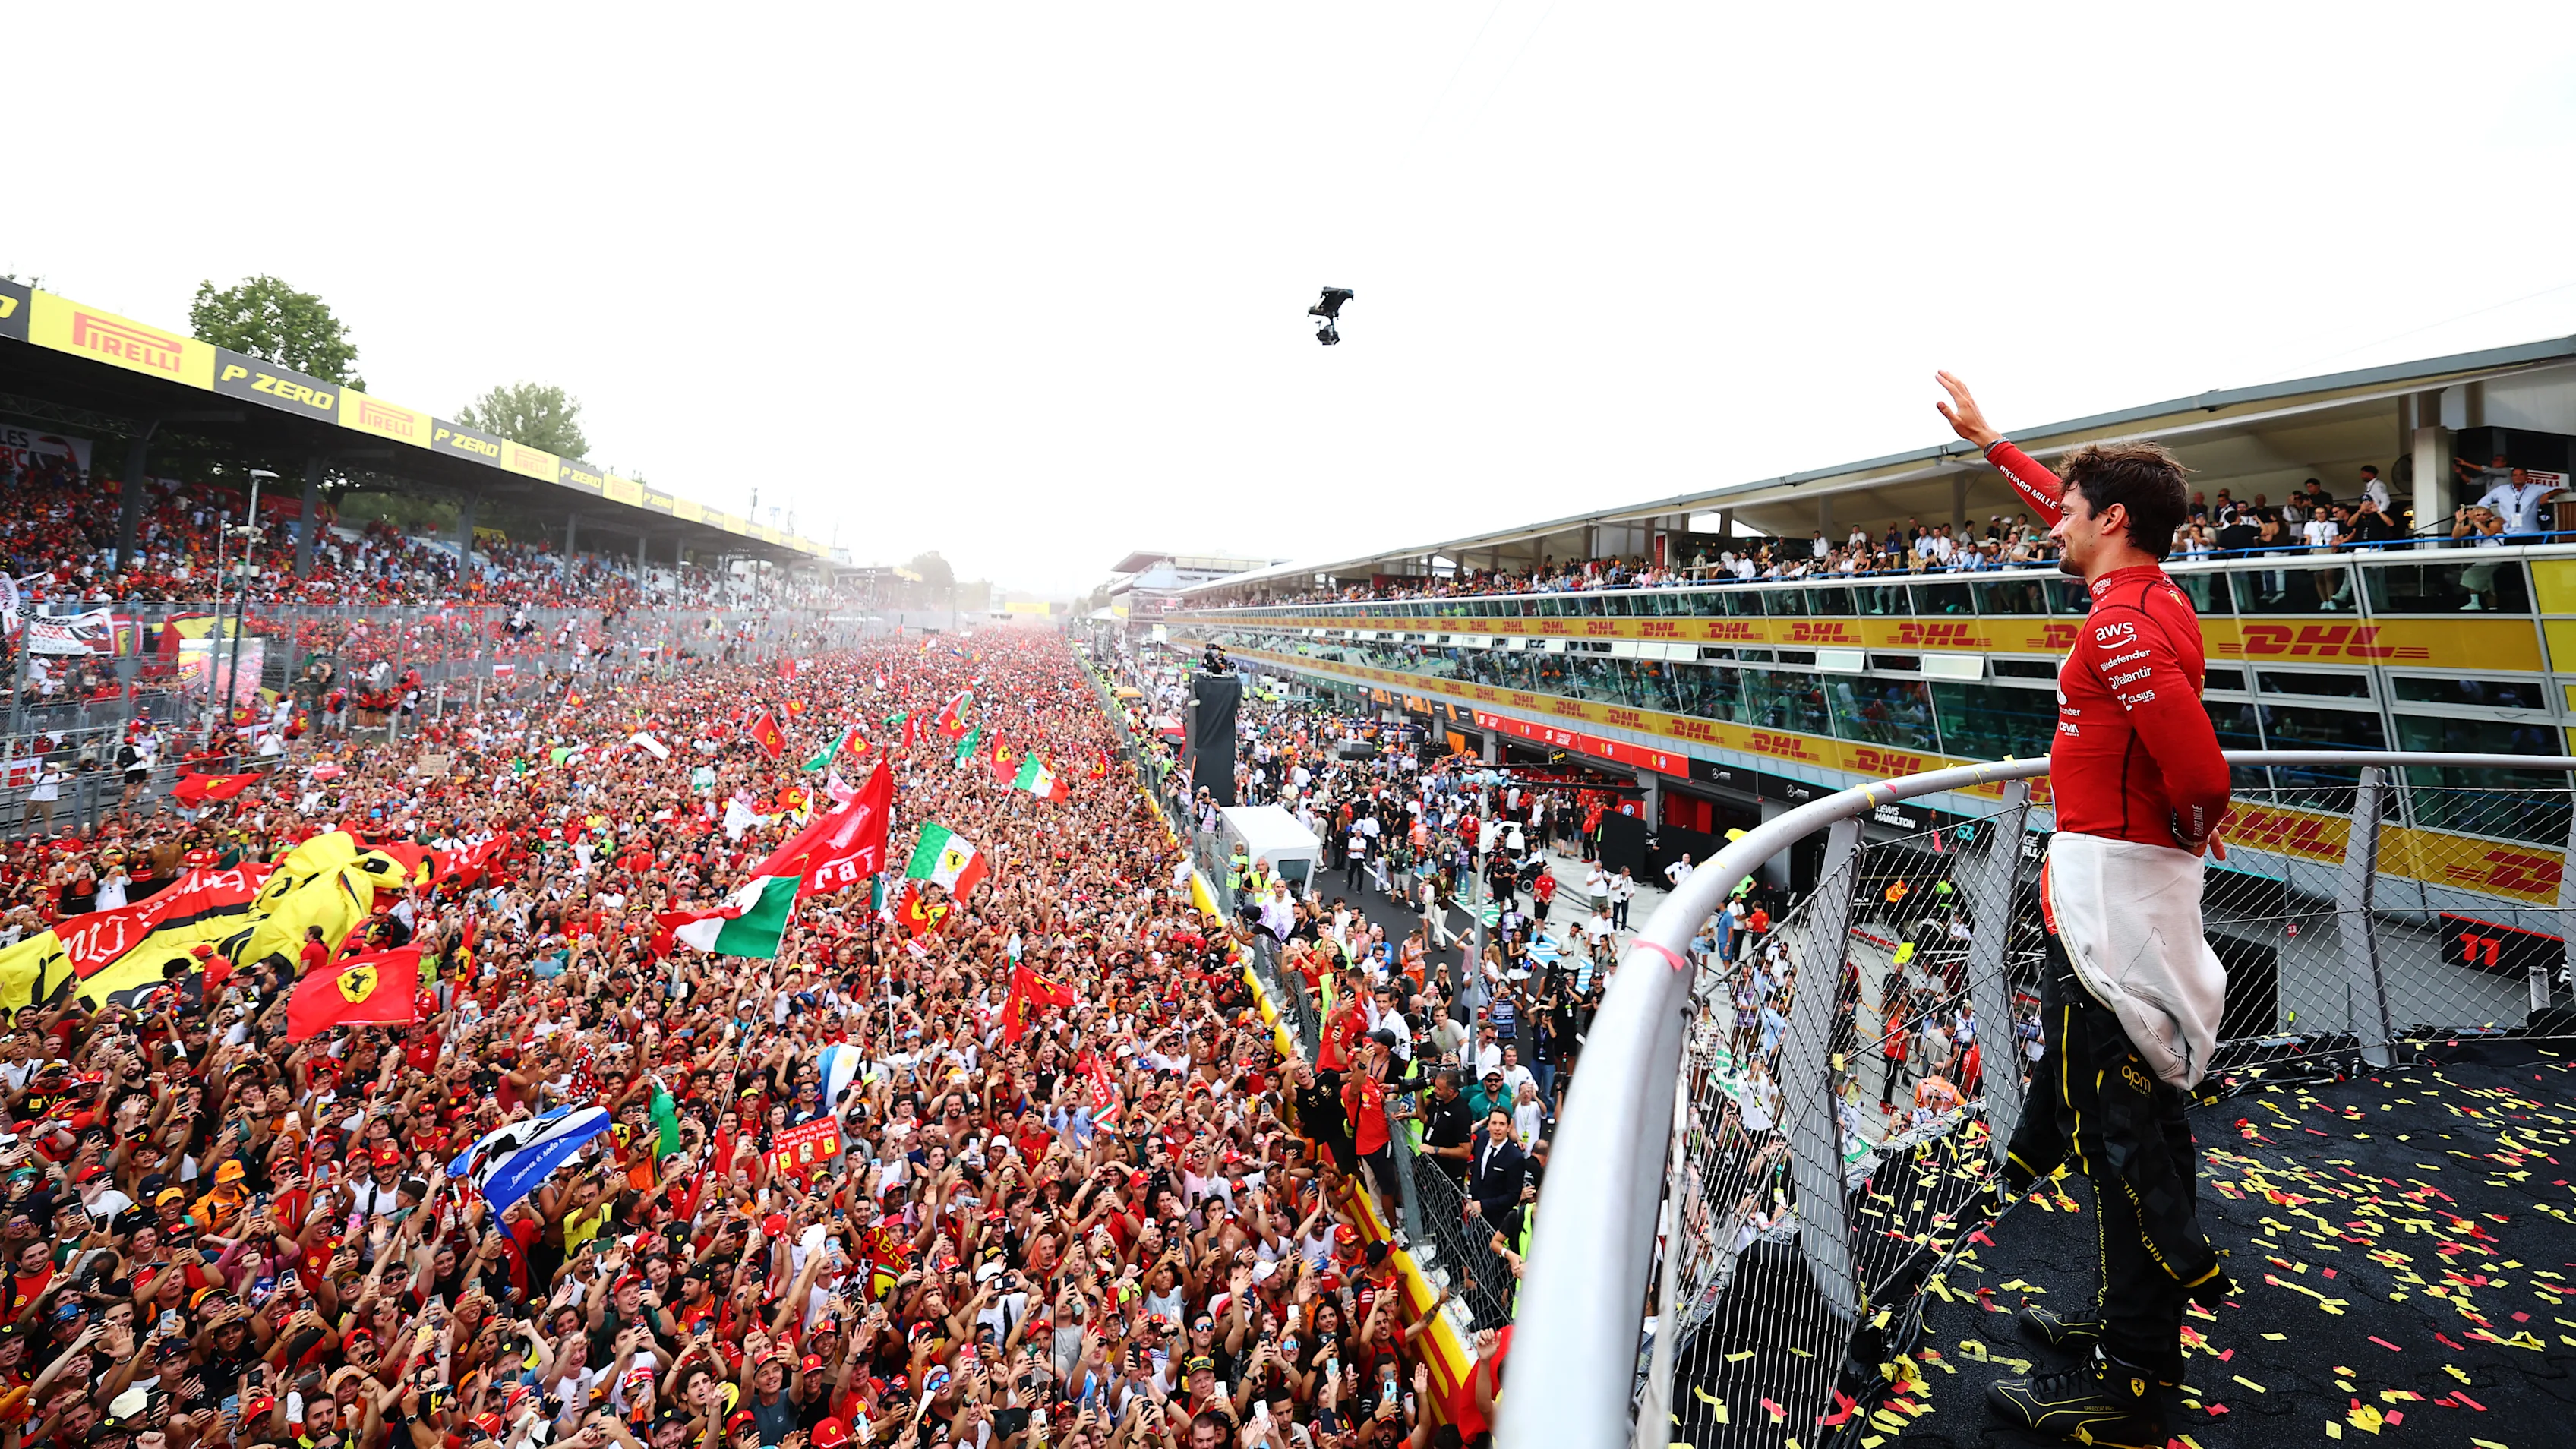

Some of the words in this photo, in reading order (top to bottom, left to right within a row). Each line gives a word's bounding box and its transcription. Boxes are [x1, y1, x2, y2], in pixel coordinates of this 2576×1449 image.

[73, 311, 182, 373] PIRELLI
[221, 365, 248, 383] P
[251, 377, 335, 411] ZERO
[359, 399, 414, 437] PIRELLI
[434, 428, 450, 441] P
[450, 433, 499, 457] ZERO
[514, 448, 548, 475] PIRELLI
[560, 467, 570, 478] P
[570, 470, 603, 489] ZERO
[1999, 465, 2031, 493] RICHARD
[2031, 489, 2058, 510] MILLE
[1471, 621, 1488, 631] DHL
[1503, 621, 1524, 632] DHL
[1542, 621, 1566, 633] DHL
[1587, 622, 1617, 635] DHL
[1642, 622, 1679, 636] DHL
[1709, 623, 1755, 639] DHL
[1792, 623, 1849, 642] DHL
[1899, 623, 1975, 646] DHL
[2095, 622, 2135, 642] aws
[2242, 625, 2395, 658] DHL
[2100, 649, 2151, 672] Bitdefender
[2116, 665, 2152, 687] Palantir
[1513, 693, 1535, 708] DHL
[2128, 690, 2155, 703] CELSIUS
[1557, 701, 1586, 718] DHL
[1608, 709, 1644, 728] DHL
[2060, 707, 2080, 716] ander
[1672, 719, 1716, 741] DHL
[2059, 721, 2079, 733] CEVA
[1751, 733, 1809, 759] DHL
[1877, 804, 1899, 816] LEWIS
[1874, 813, 1917, 829] HAMILTON
[1957, 822, 1976, 841] 63
[2458, 933, 2500, 968] 11
[2122, 1065, 2151, 1092] apm
[2120, 1174, 2140, 1206] MIL
[2136, 1208, 2163, 1261] RICHD
